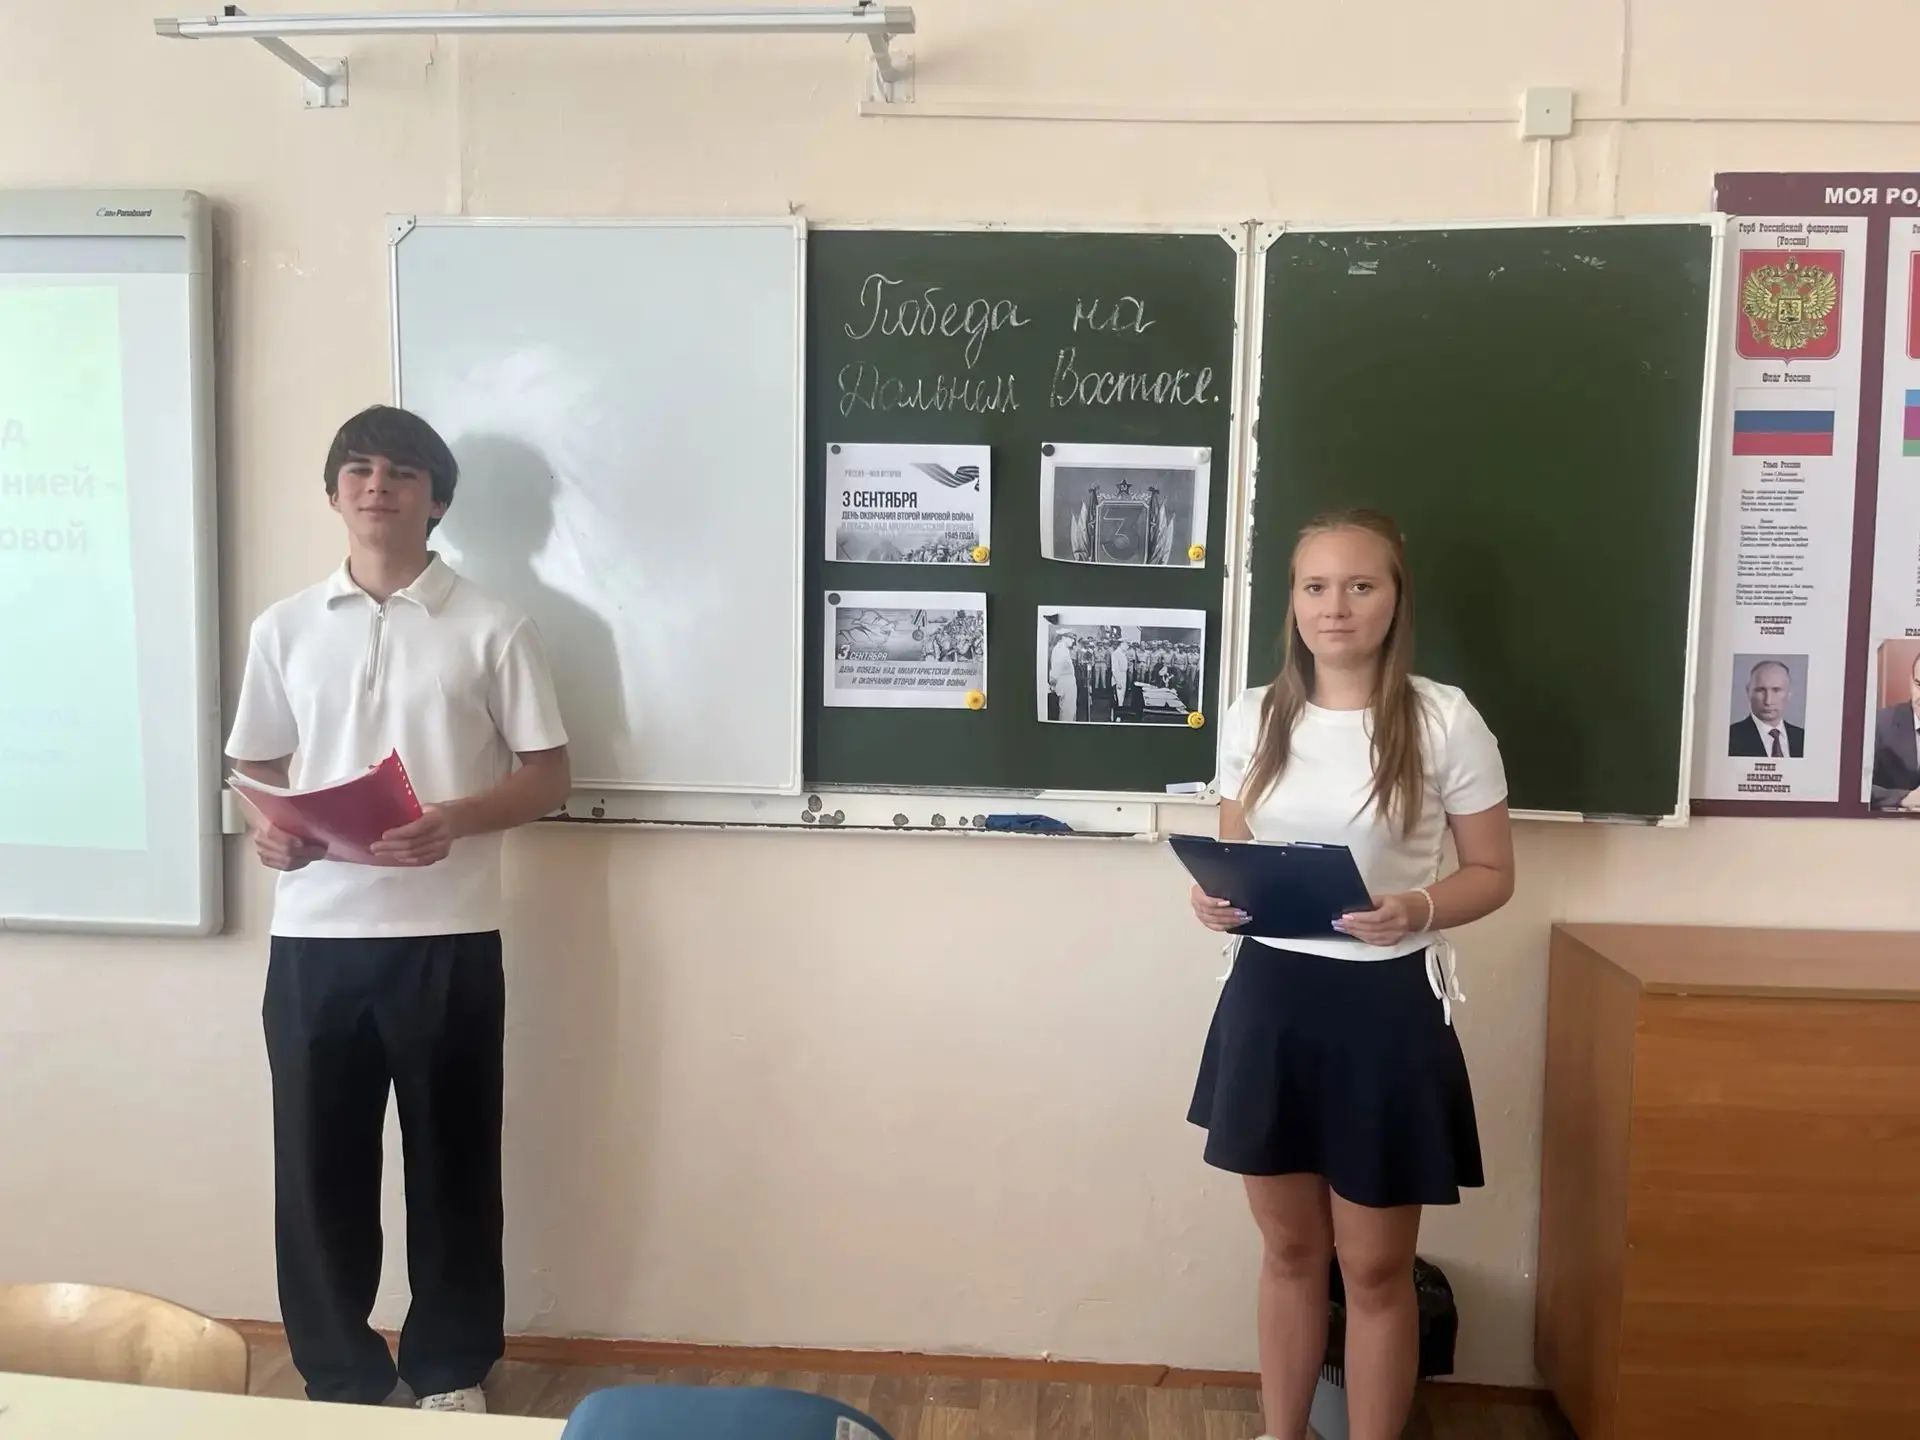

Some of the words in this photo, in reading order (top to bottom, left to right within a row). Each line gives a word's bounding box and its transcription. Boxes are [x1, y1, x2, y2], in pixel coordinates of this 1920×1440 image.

[1825, 188, 1877, 204] МОЯ
[1886, 188, 1920, 208] РО
[1739, 223, 1755, 235] Герб
[845, 273, 1031, 369] Победа
[1073, 296, 1156, 333] на
[838, 361, 1020, 417] Дальнем
[1050, 347, 1220, 408] Востоке.
[842, 491, 851, 508] 3
[853, 491, 918, 509] СЕНТЯБРЯ
[841, 511, 859, 520] ДЕНЬ
[859, 511, 897, 521] ОКОНЧАНИЯ
[897, 511, 920, 521] ВТОРОЙ
[921, 511, 951, 521] МИРОВОЙ
[951, 511, 975, 522] ВОЙНЫ
[959, 532, 975, 540] ГОДА
[837, 644, 851, 660] 3
[850, 652, 888, 661] СЕНТЯБРЯ
